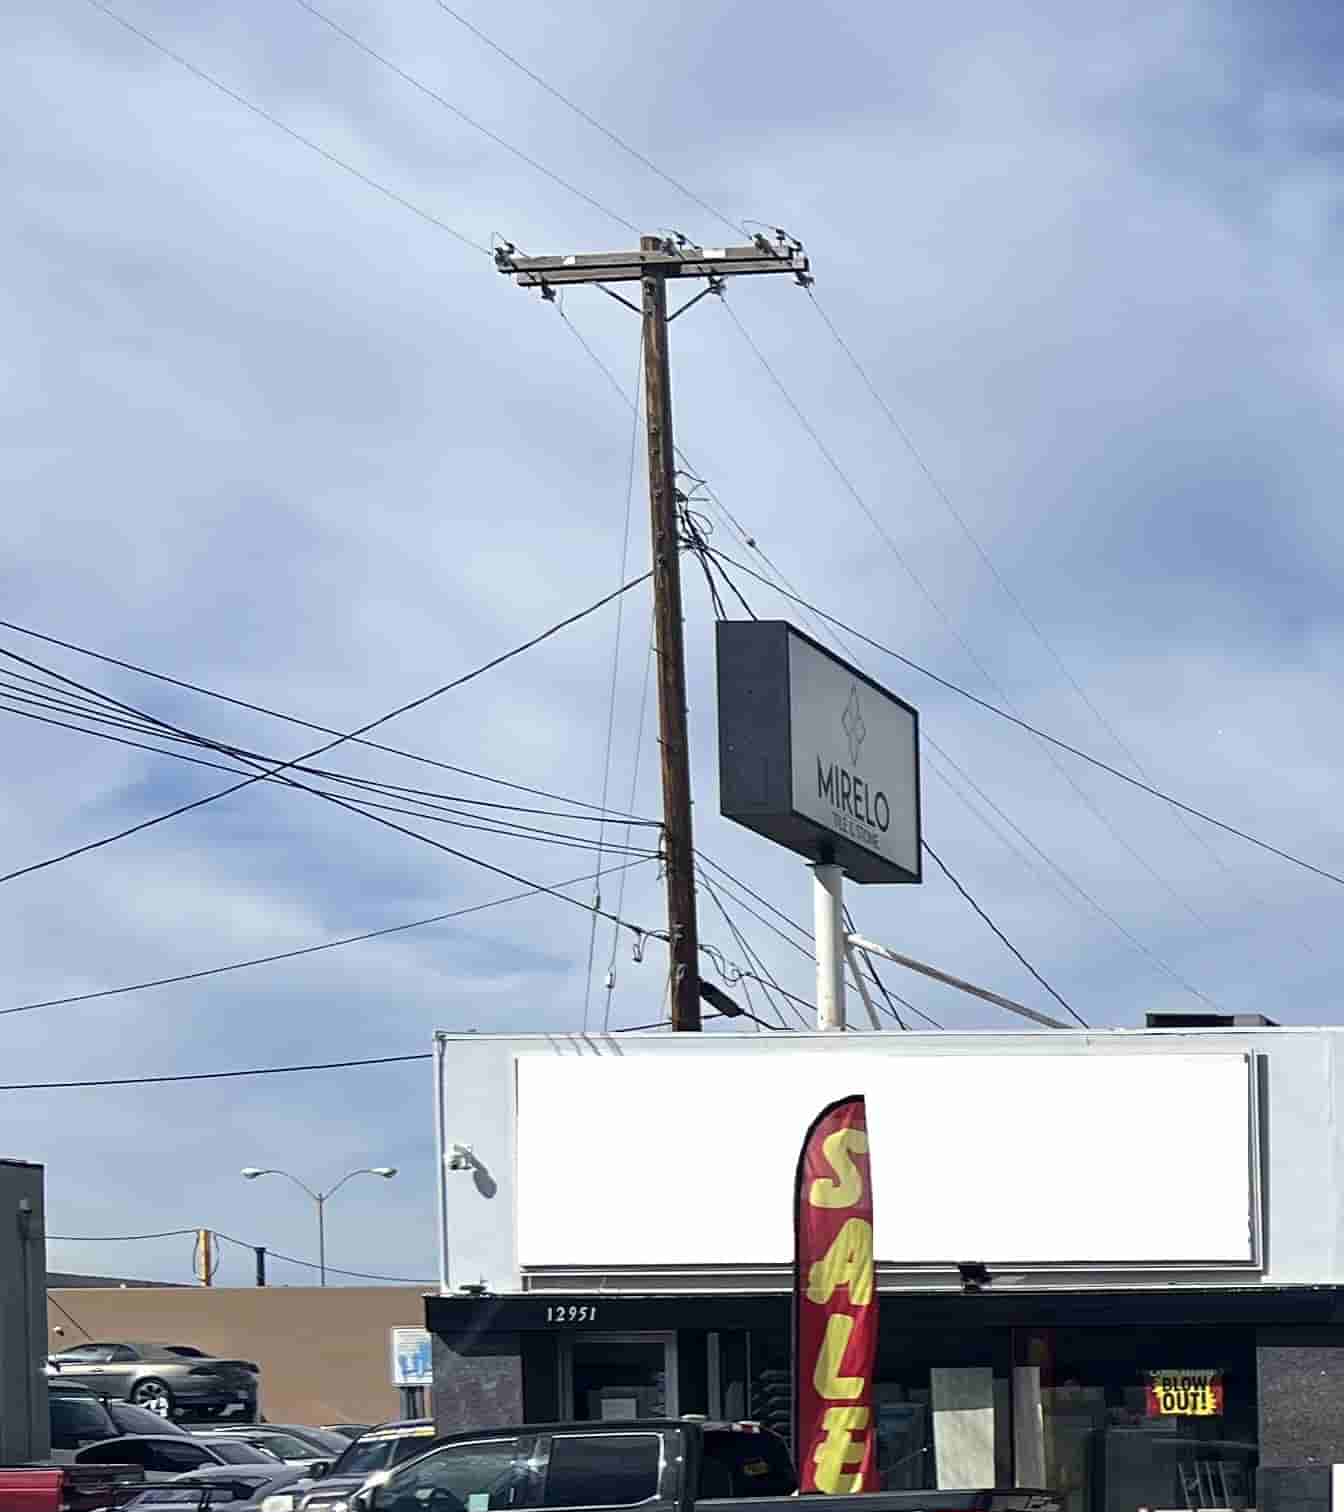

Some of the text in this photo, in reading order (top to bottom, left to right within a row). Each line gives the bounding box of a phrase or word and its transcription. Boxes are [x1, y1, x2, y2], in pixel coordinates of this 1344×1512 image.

[816, 752, 890, 833] MIRELO
[547, 1306, 597, 1322] 12951
[806, 1127, 874, 1494] SALE
[1163, 1375, 1209, 1391] BLOW
[1163, 1392, 1207, 1410] OUT!
